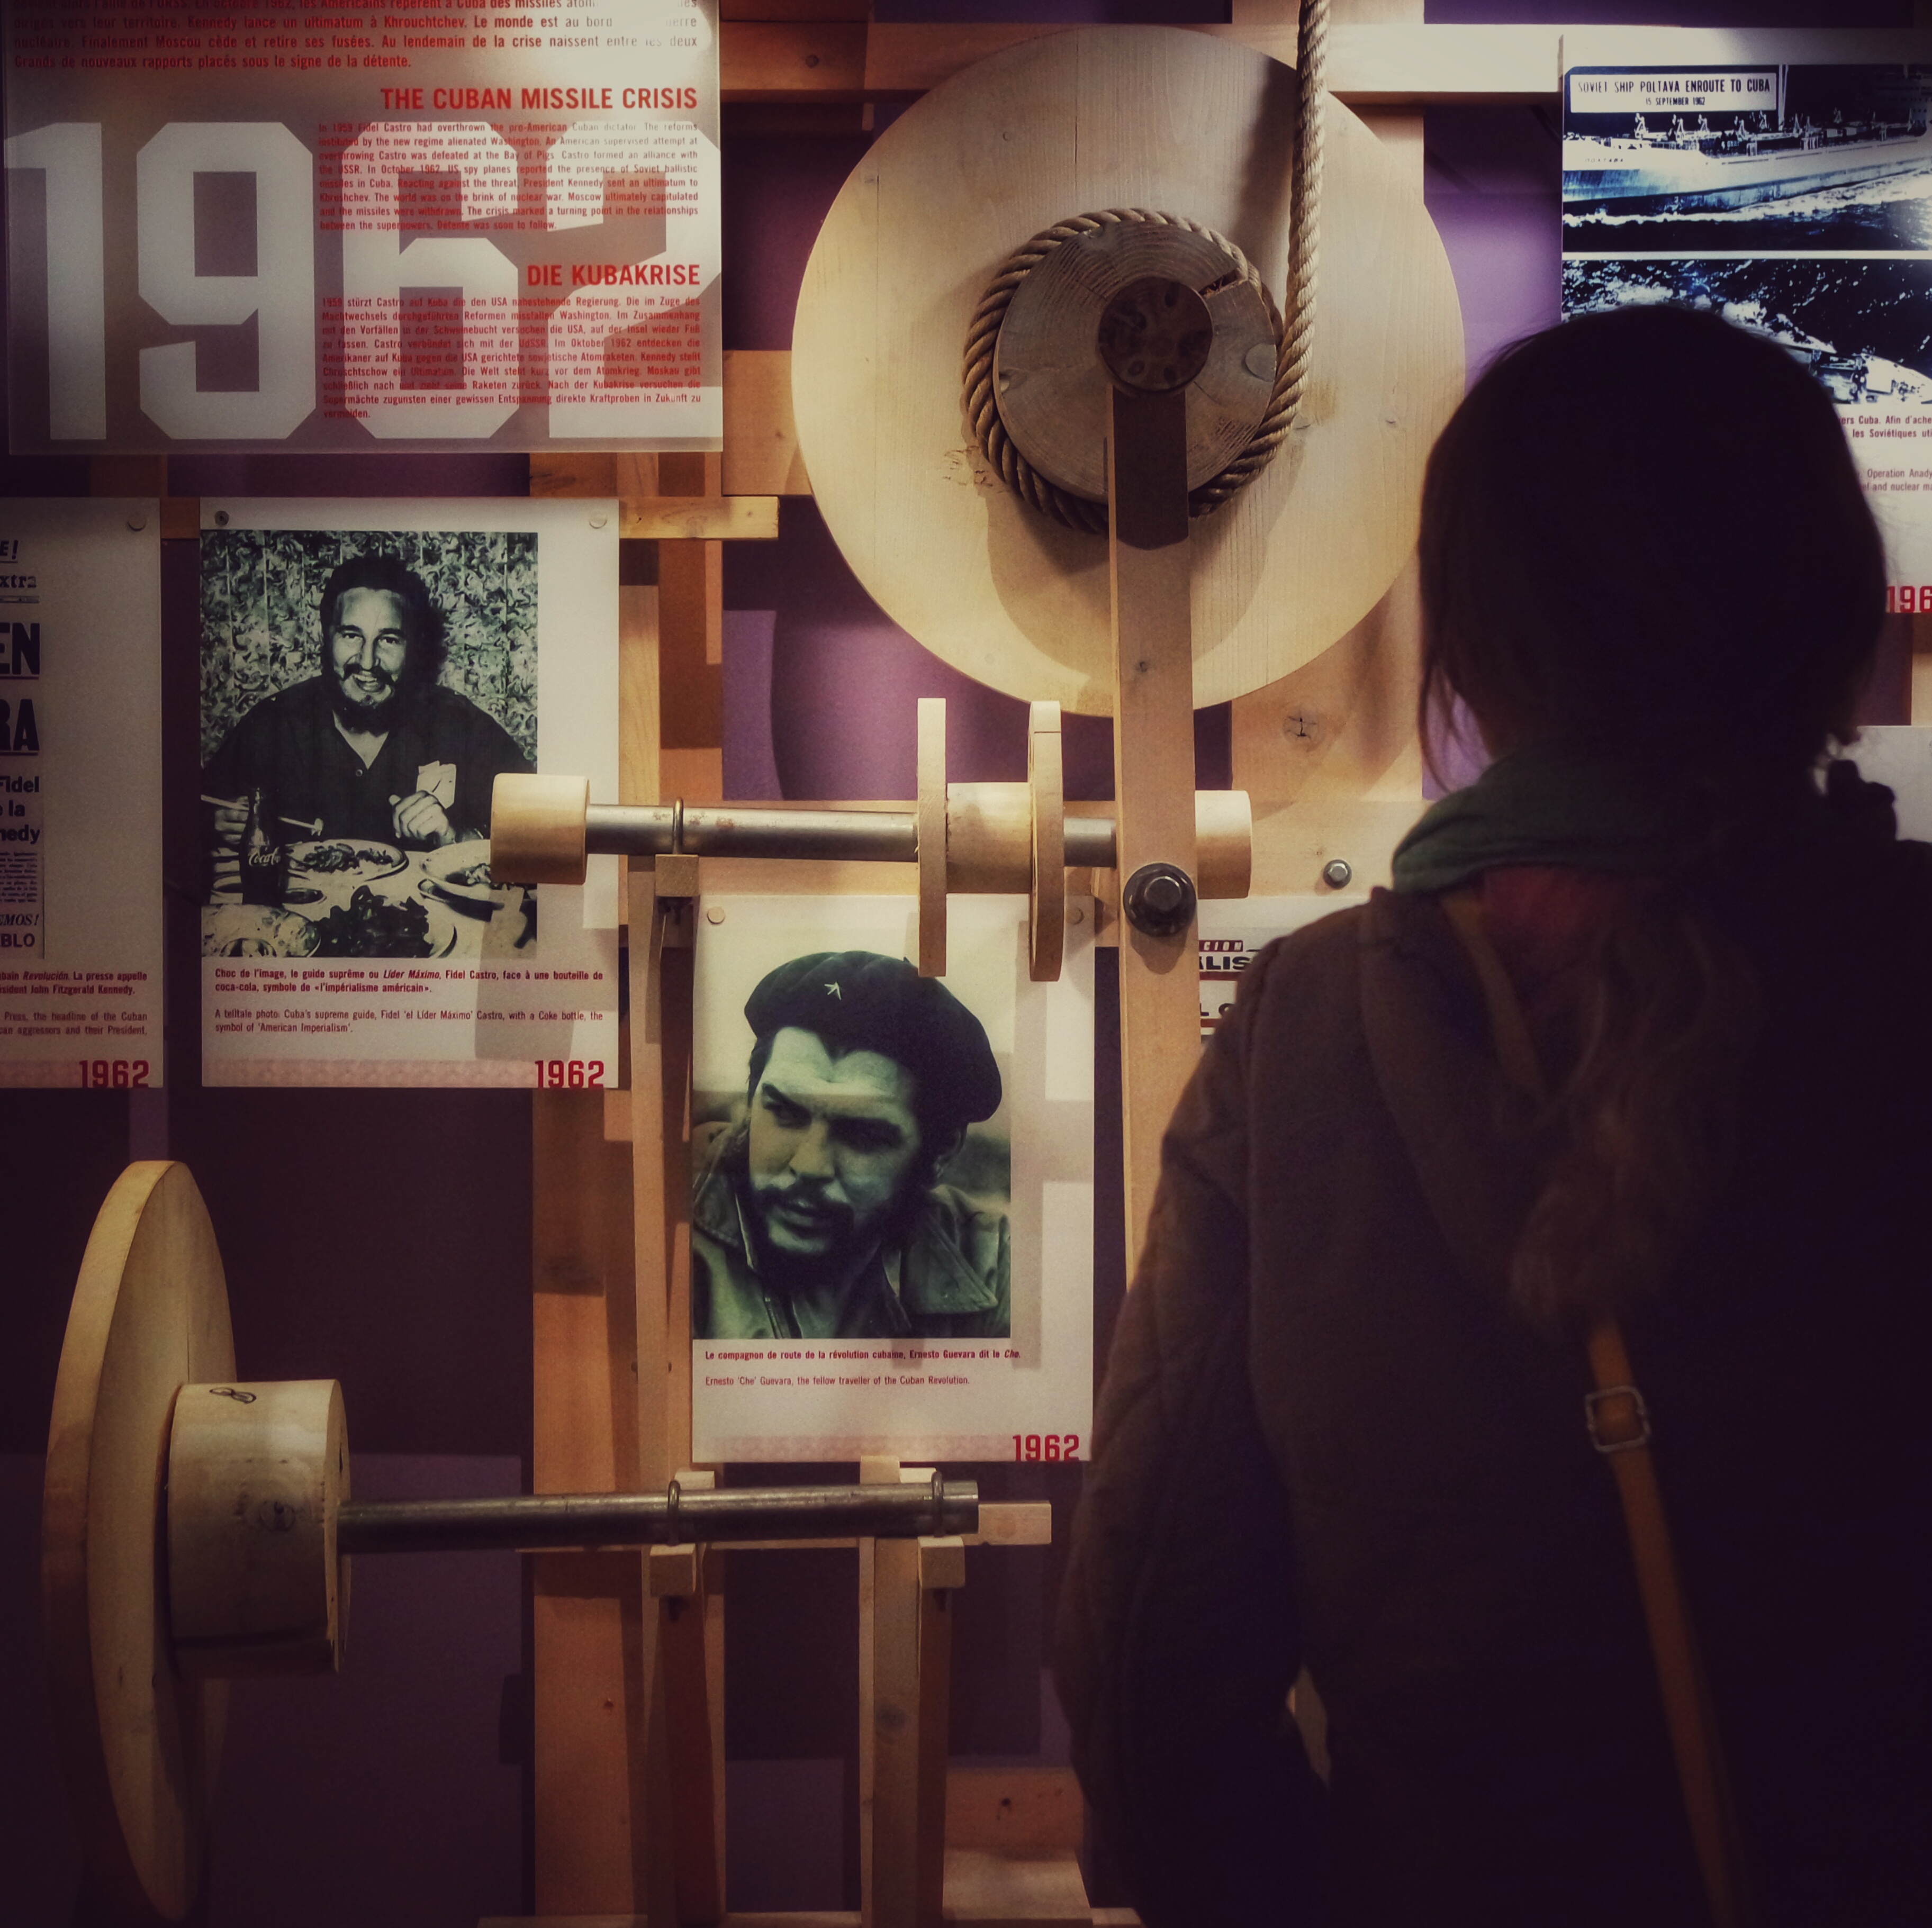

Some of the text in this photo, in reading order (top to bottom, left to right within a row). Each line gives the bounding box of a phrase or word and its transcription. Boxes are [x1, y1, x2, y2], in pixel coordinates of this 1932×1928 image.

[14, 54, 412, 69] Grands de nouveaux rapports placés sous le signe de la détente.
[1614, 81, 1635, 93] SHIP
[1640, 80, 1681, 93] POLTAVA
[1685, 79, 1726, 93] ENROUTE
[1730, 79, 1741, 92] TO
[1746, 78, 1771, 92] CUBA
[381, 87, 698, 110] THE CUBAN MISSILE CRISIS
[1655, 97, 1690, 106] SEPTEMBER
[378, 150, 407, 160] Castro
[411, 152, 427, 160] was
[431, 150, 469, 160] defeated
[473, 151, 482, 160] at
[485, 151, 499, 160] the
[503, 150, 519, 161] Bay
[523, 150, 532, 160] of
[561, 150, 589, 160] Castro
[680, 151, 698, 159] with
[5, 122, 722, 440] 1962
[527, 264, 701, 286] DIE KUBAKRISE
[1885, 415, 1901, 424] Afin
[1852, 429, 1865, 438] les
[1869, 429, 1917, 440] Soviétiques
[1867, 468, 1905, 479] Operation
[1872, 482, 1888, 491] and
[1890, 482, 1920, 491] nuclear
[73, 971, 83, 979] La
[86, 973, 114, 981] presse
[117, 972, 148, 983] appelle
[214, 968, 603, 980] Choc de l'image, le guide suprême ou Líder Máximo, Fidel Castro, face à une bouteille de
[263, 982, 297, 993] symbole
[300, 982, 311, 992] de
[214, 1009, 221, 1019] A
[224, 1009, 252, 1019] telltale
[284, 1009, 311, 1019] Cuba's
[314, 1011, 349, 1020] supreme
[381, 1009, 400, 1019] Fidel
[417, 1009, 436, 1020] Líder
[509, 1011, 526, 1020] with
[529, 1012, 535, 1021] a
[538, 1010, 558, 1021] Coke
[590, 1011, 603, 1021] the
[214, 1023, 243, 1032] symbol
[246, 1022, 255, 1032] of
[78, 1060, 150, 1089] 1962
[534, 1060, 605, 1089] 1962
[705, 1348, 1021, 1361] Le compagnon de route de la révolution cubaine, Ernesto Guevara dit le Che.
[705, 1376, 734, 1386] Ernesto
[760, 1377, 793, 1386] Guevara,
[797, 1376, 810, 1385] the
[812, 1375, 836, 1386] fellow
[838, 1376, 870, 1385] traveller
[873, 1376, 881, 1386] of
[884, 1376, 897, 1385] the
[899, 1375, 925, 1385] Cuban
[928, 1375, 970, 1385] Revolution.
[1012, 1434, 1080, 1462] 1962
